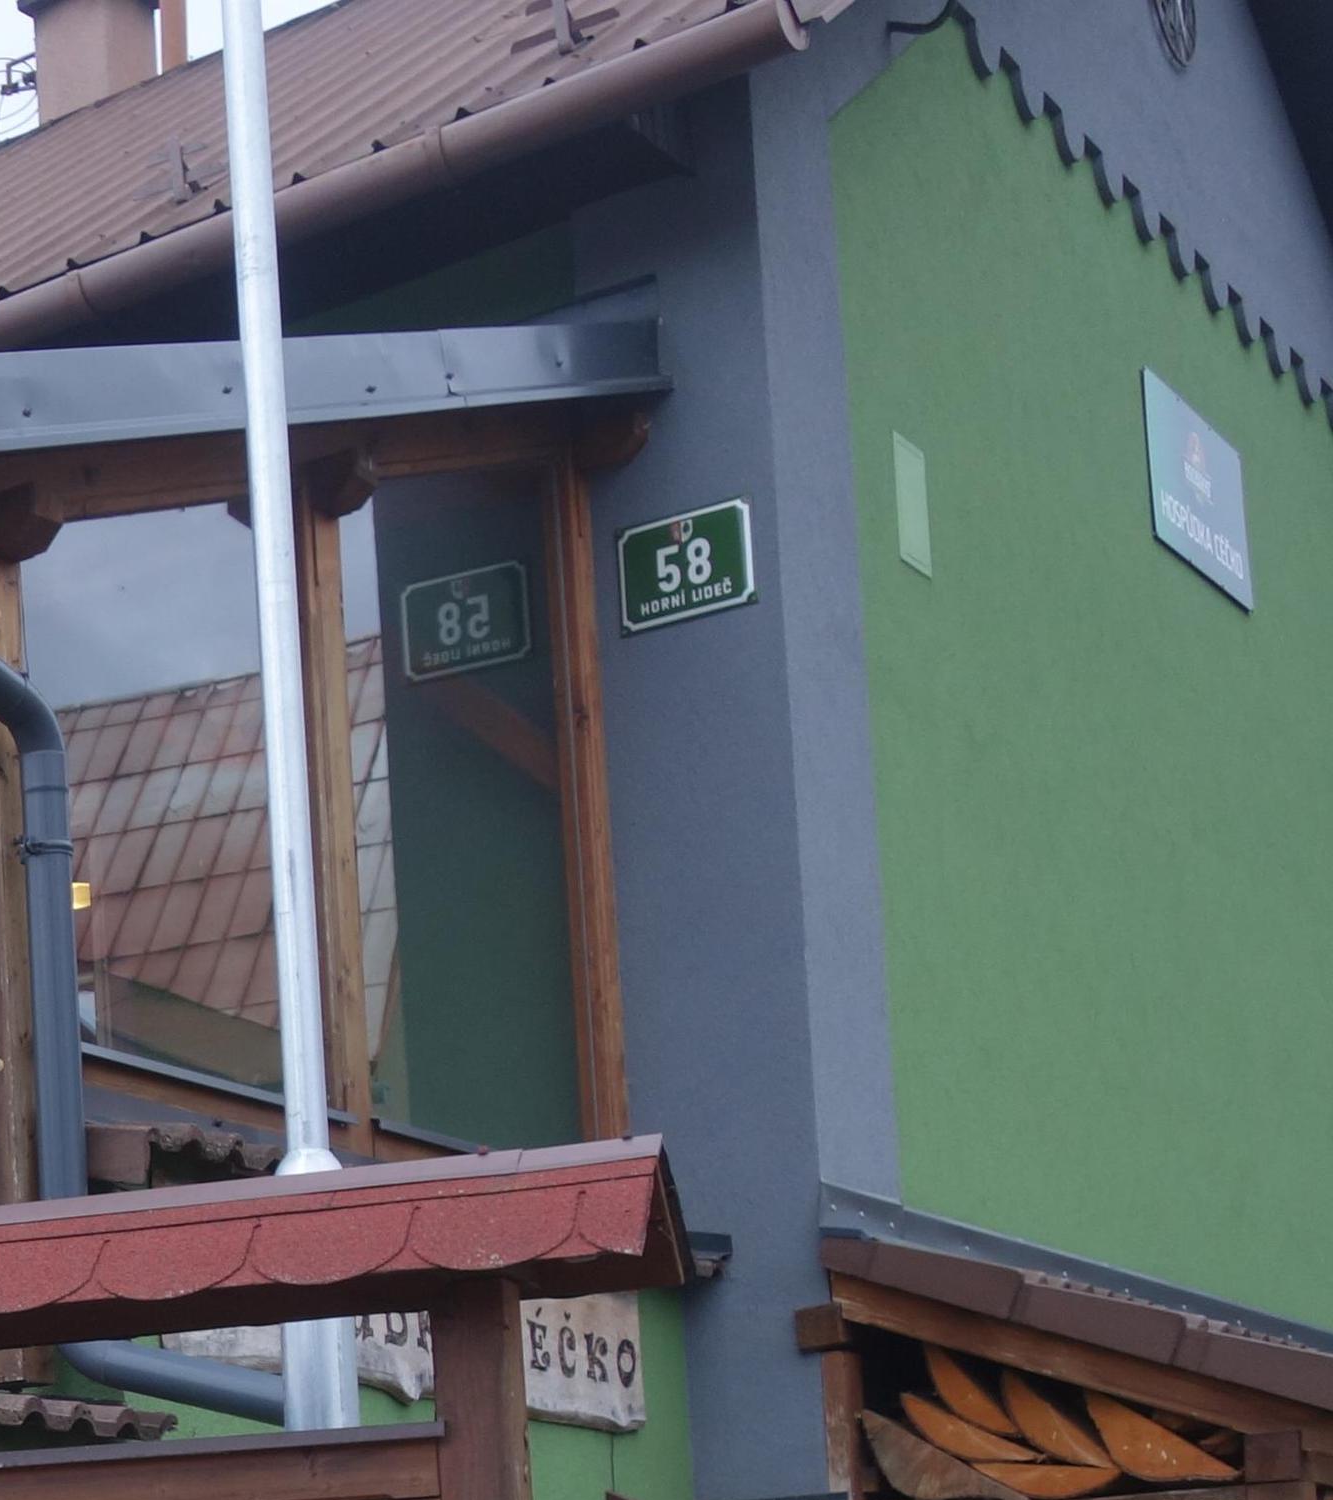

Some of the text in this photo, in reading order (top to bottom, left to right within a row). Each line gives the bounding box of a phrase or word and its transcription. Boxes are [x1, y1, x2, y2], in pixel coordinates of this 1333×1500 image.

[655, 537, 713, 594] 58
[640, 576, 733, 617] HORNÍ LIDEČ
[527, 1307, 637, 1389] ÉČKO
